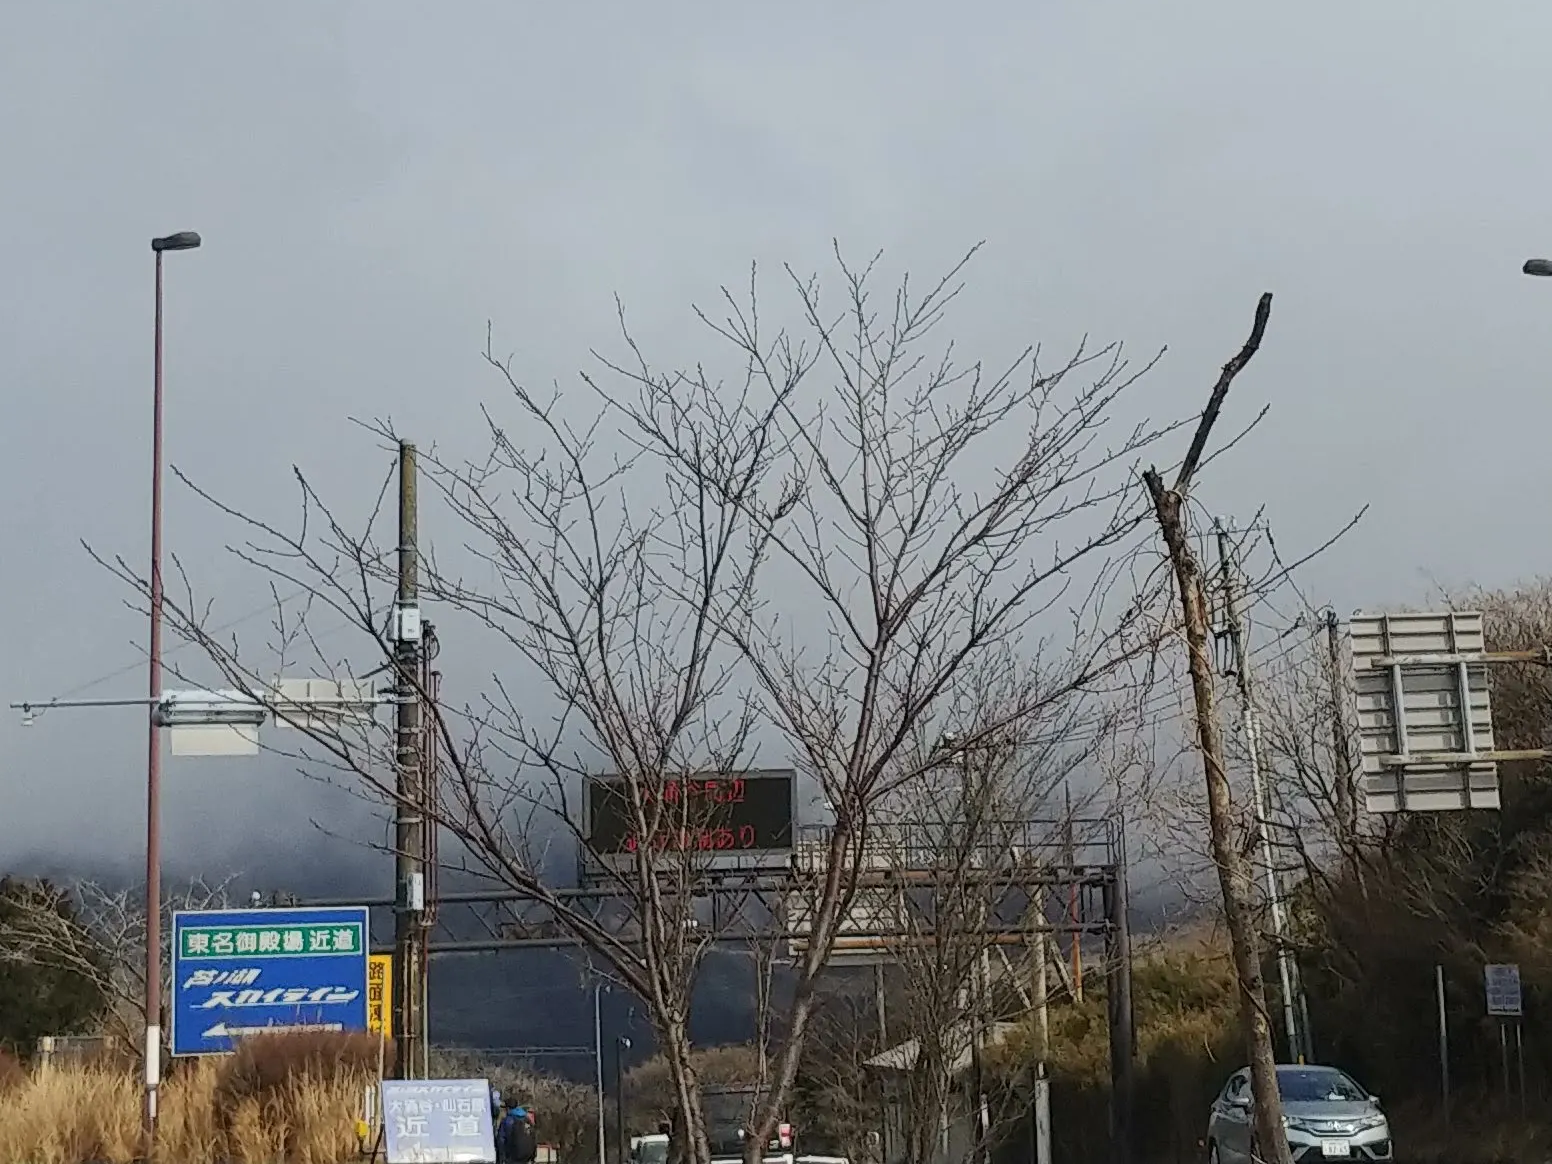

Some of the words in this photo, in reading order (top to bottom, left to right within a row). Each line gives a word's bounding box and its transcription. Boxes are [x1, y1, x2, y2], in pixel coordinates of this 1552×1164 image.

[309, 928, 355, 951] 近道
[201, 986, 360, 1009] スカイライン
